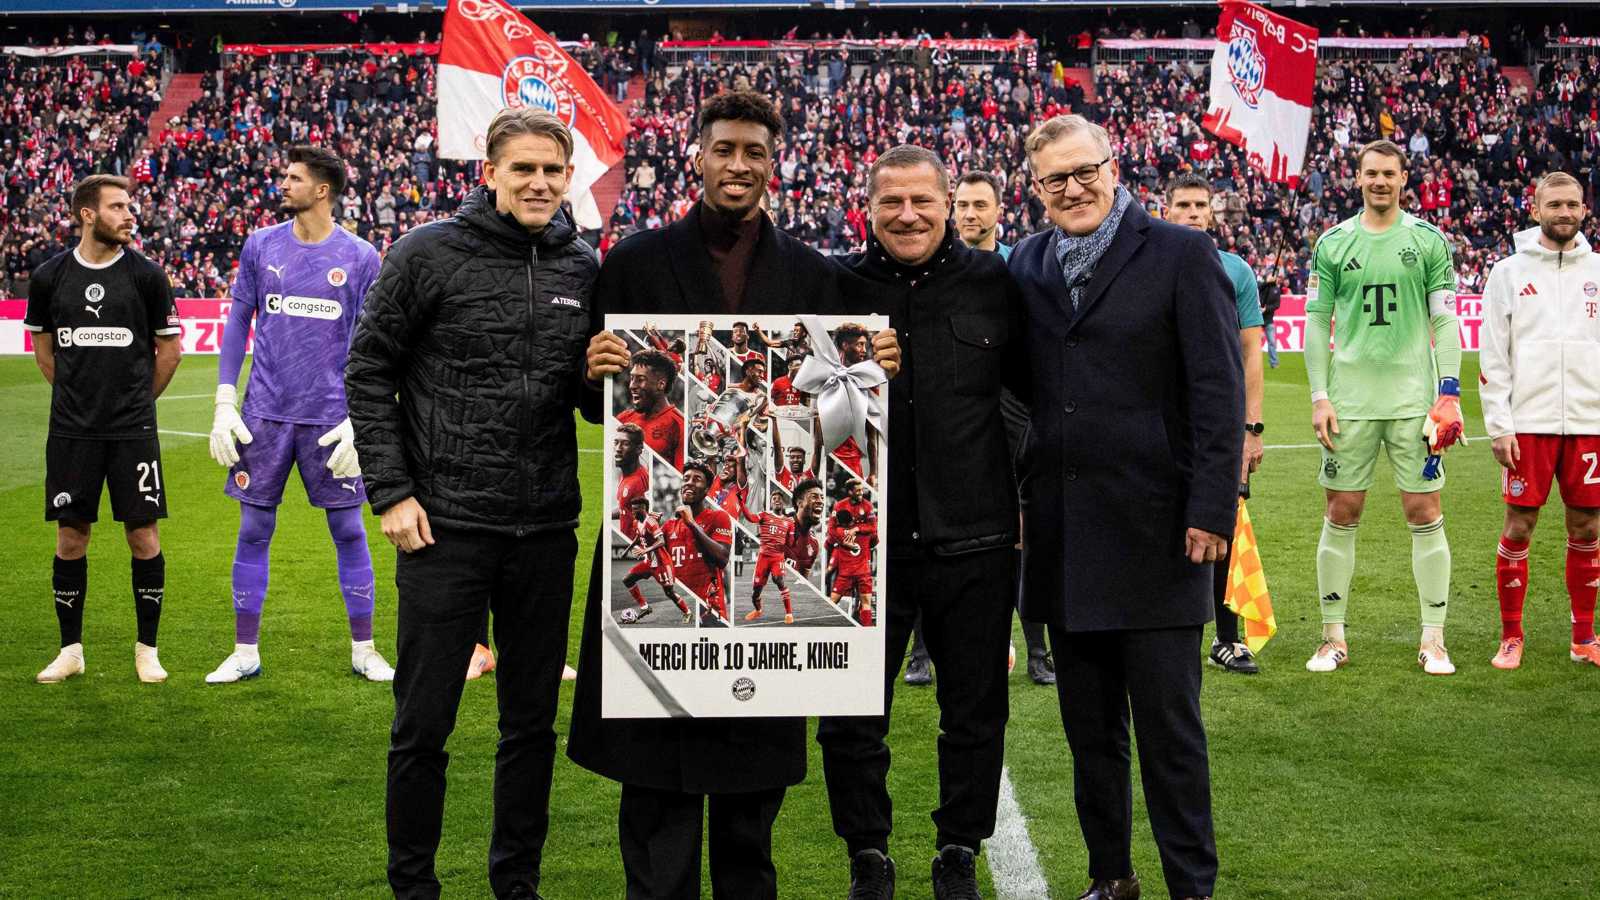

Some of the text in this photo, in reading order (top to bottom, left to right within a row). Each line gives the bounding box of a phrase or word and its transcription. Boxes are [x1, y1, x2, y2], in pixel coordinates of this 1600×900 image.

[288, 301, 337, 314] congstar
[78, 332, 128, 344] congstar
[136, 460, 161, 492] 21
[639, 637, 849, 672] MERCI FÜR 10 JAHRE, KING!
